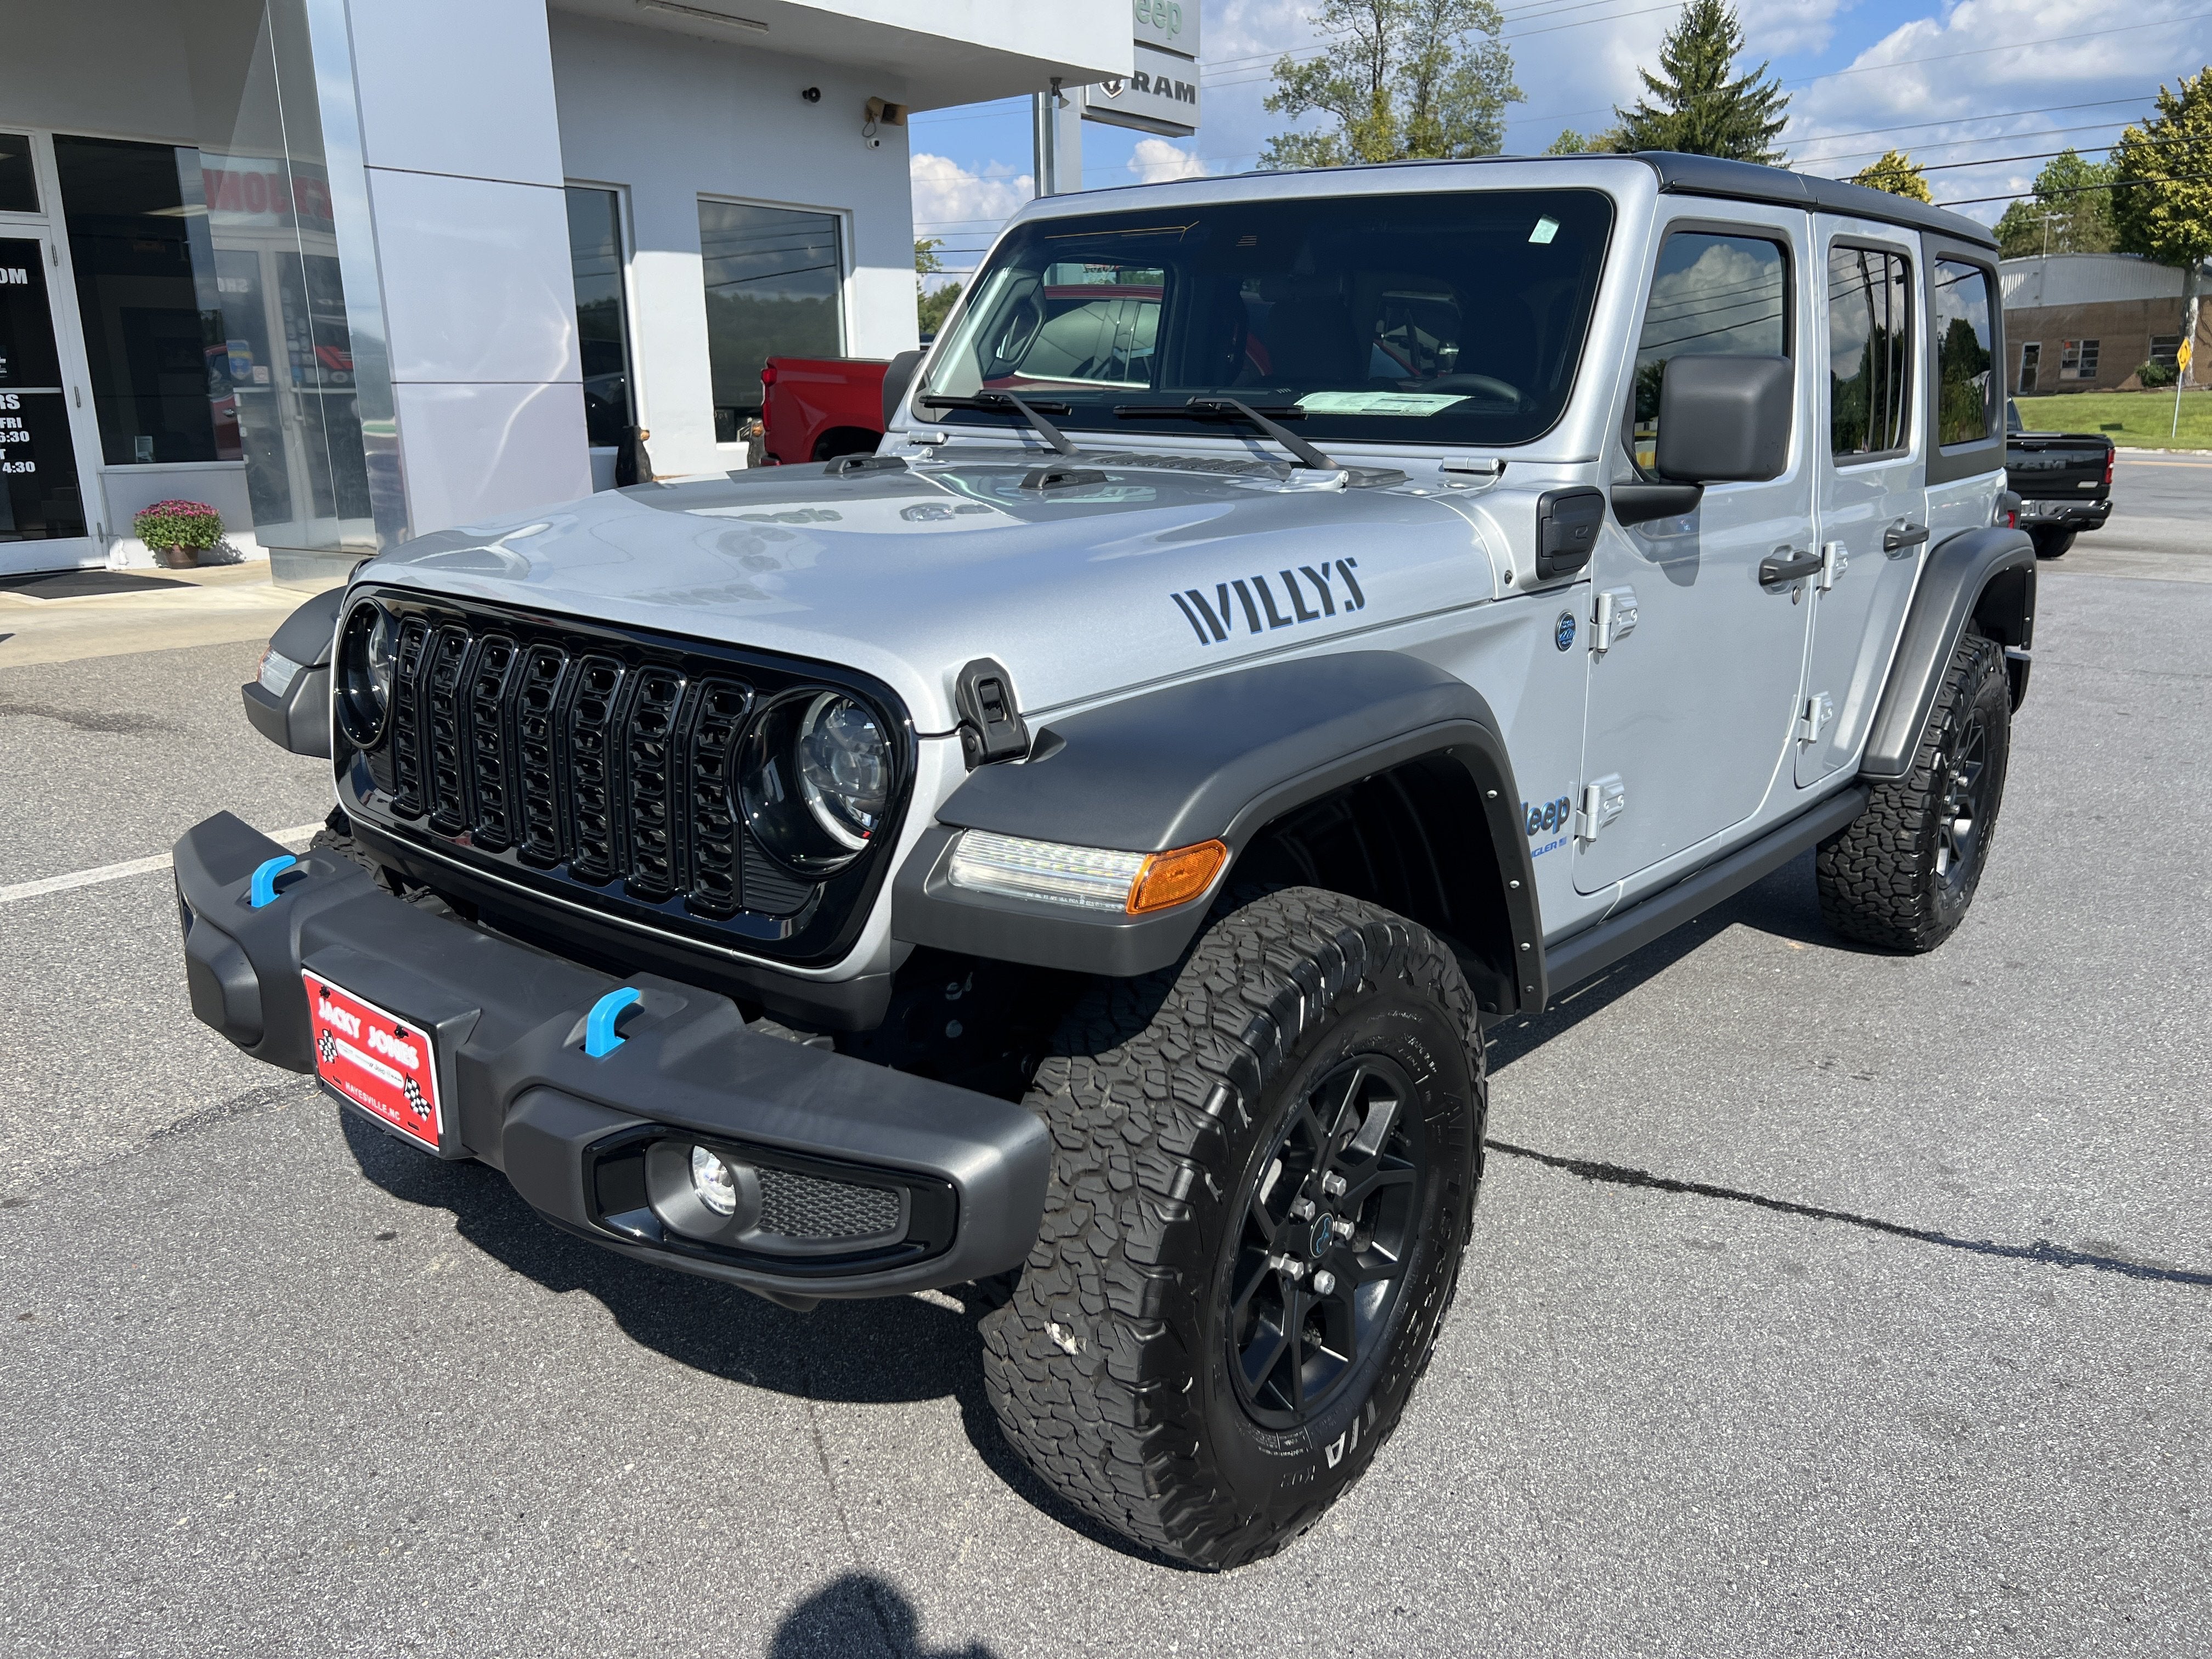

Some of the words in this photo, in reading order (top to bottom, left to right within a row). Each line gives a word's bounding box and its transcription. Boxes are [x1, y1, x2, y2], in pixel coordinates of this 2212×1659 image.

[1135, 0, 1182, 40] eep
[1131, 70, 1195, 105] RAM
[2, 461, 36, 473] 4:30
[1170, 556, 1365, 646] WILLYS
[318, 997, 362, 1039] JACKY
[367, 1025, 420, 1070] JONES
